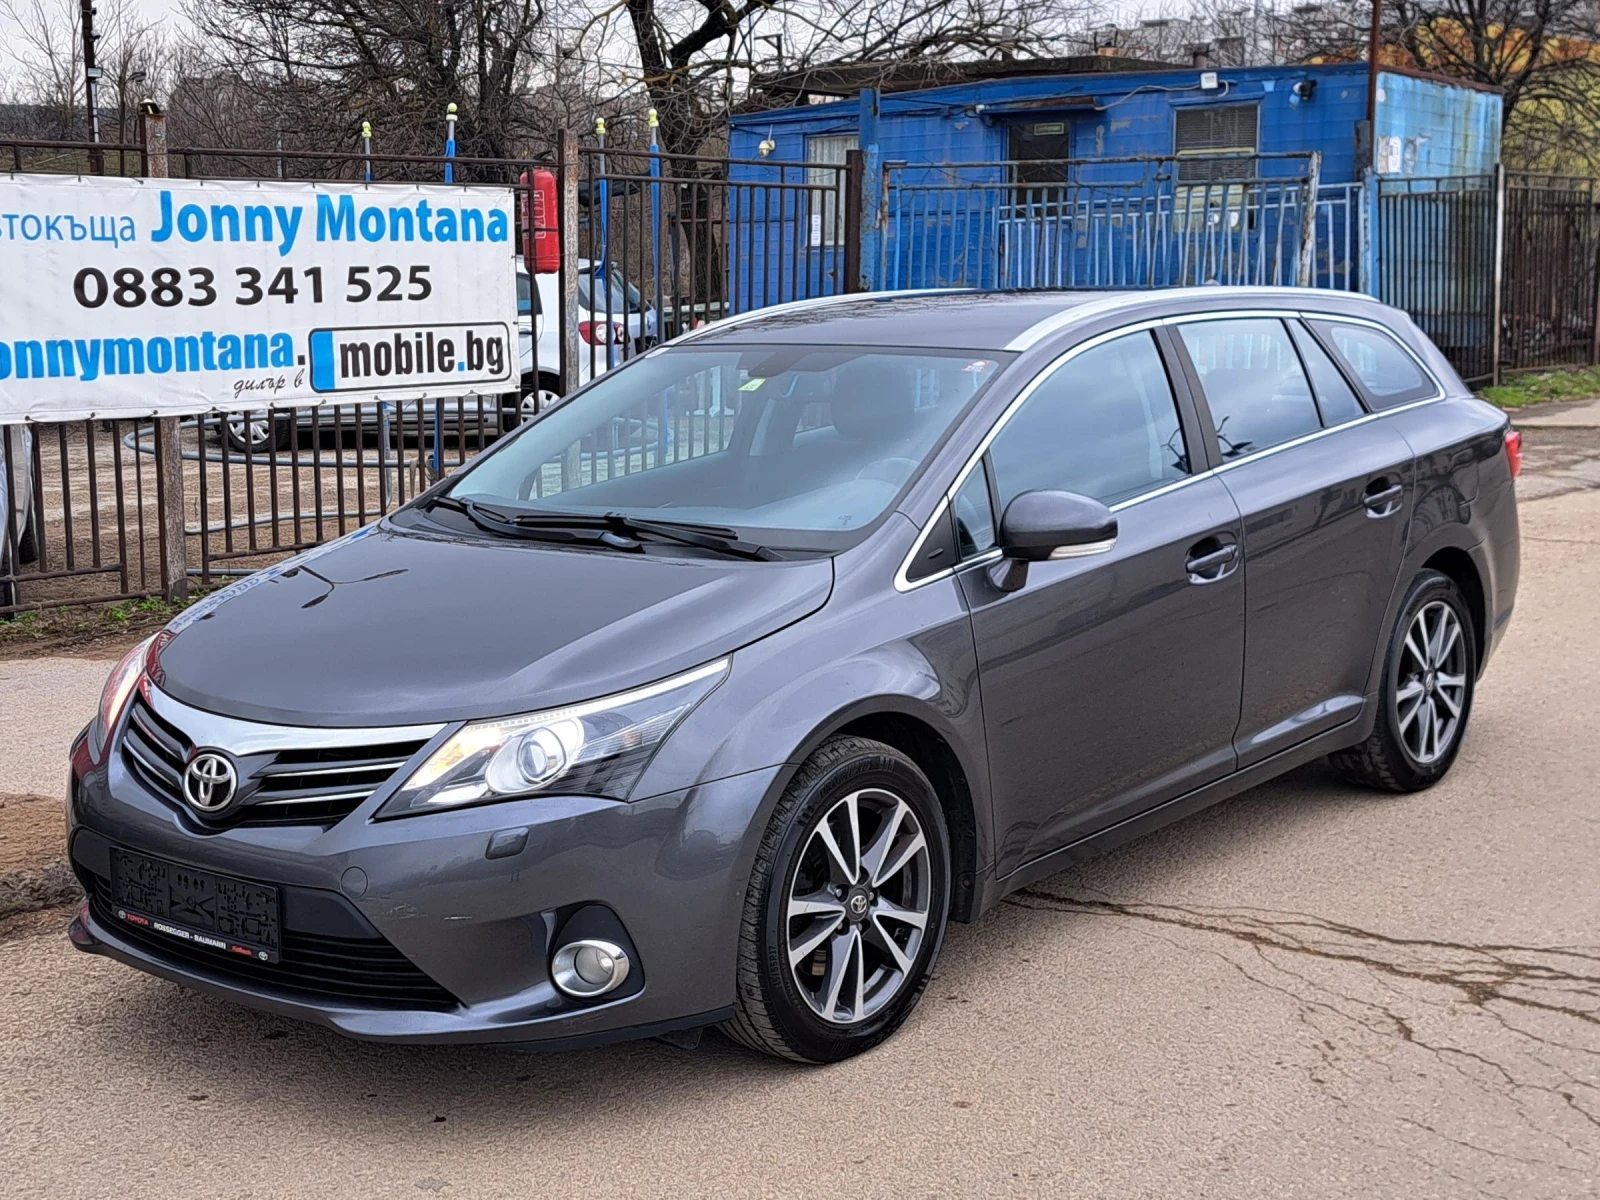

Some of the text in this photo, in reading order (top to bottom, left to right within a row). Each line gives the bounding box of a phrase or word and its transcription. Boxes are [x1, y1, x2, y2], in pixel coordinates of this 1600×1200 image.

[0, 213, 136, 249] токъща
[151, 190, 303, 257] Jonny
[316, 194, 508, 242] Montana
[73, 265, 433, 308] 0883 341 525
[339, 329, 504, 379] mobile.bg
[126, 913, 149, 925] TOYOTA
[194, 934, 227, 950] BAUMANN
